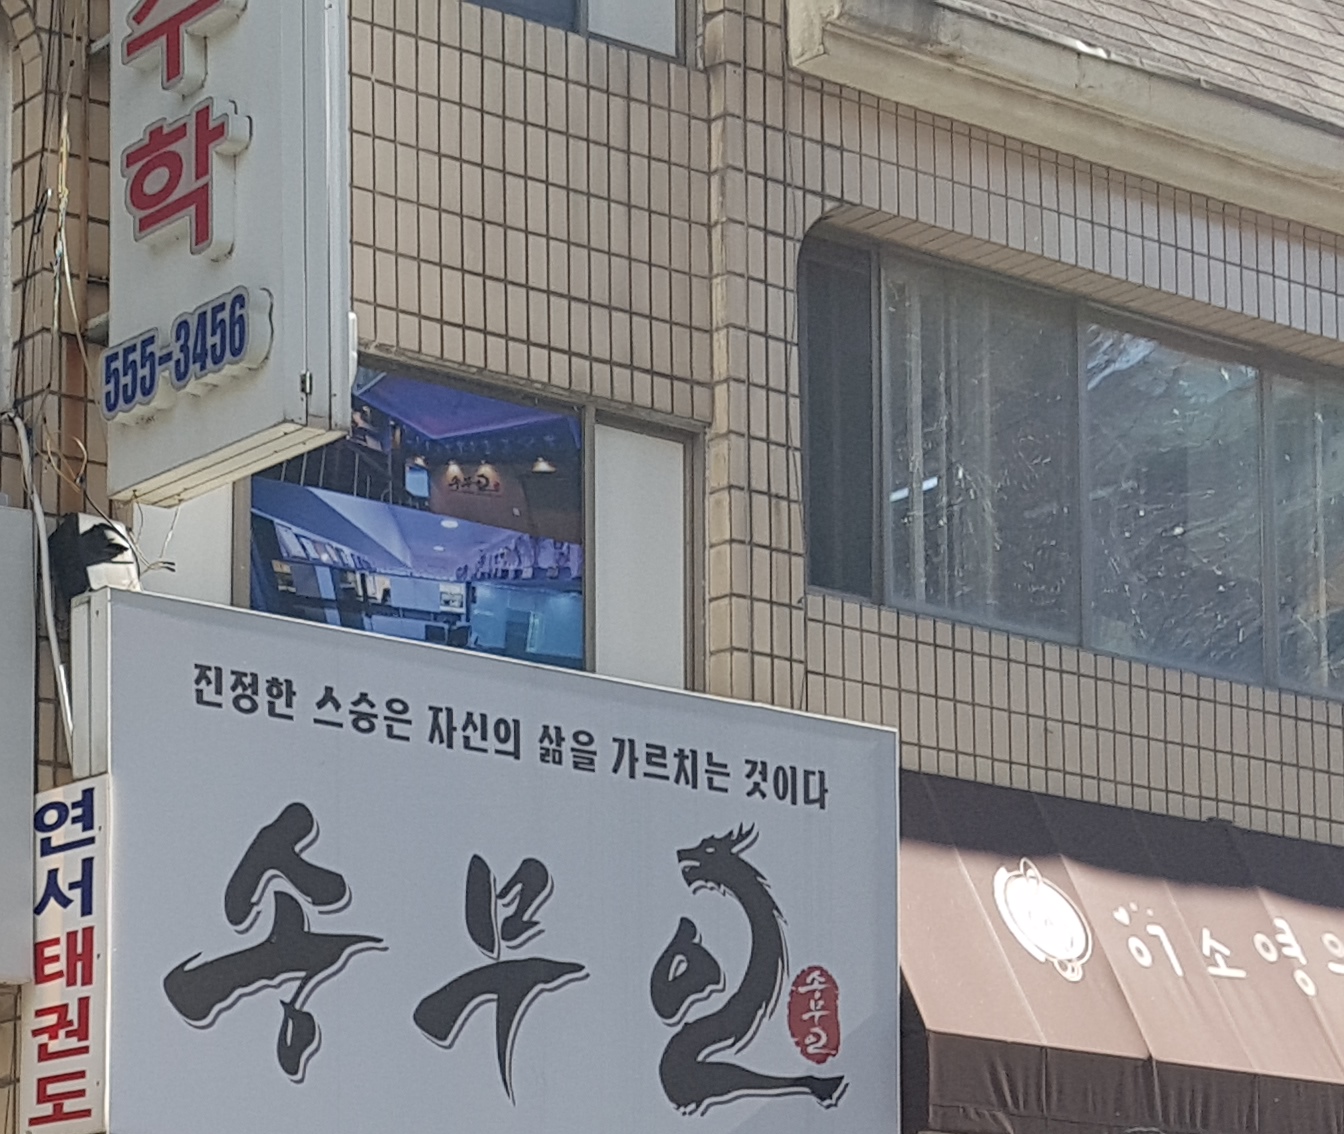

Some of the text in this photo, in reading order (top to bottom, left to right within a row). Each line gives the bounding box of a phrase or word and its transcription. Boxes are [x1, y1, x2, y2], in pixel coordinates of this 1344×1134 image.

[123, 0, 229, 248] 수학
[103, 292, 248, 416] 555-3456
[192, 662, 830, 811] 진정한 스승은 자신의 삶을 가르치는 것이다
[28, 786, 96, 1128] 연서태권도
[163, 802, 850, 1118] 송무인
